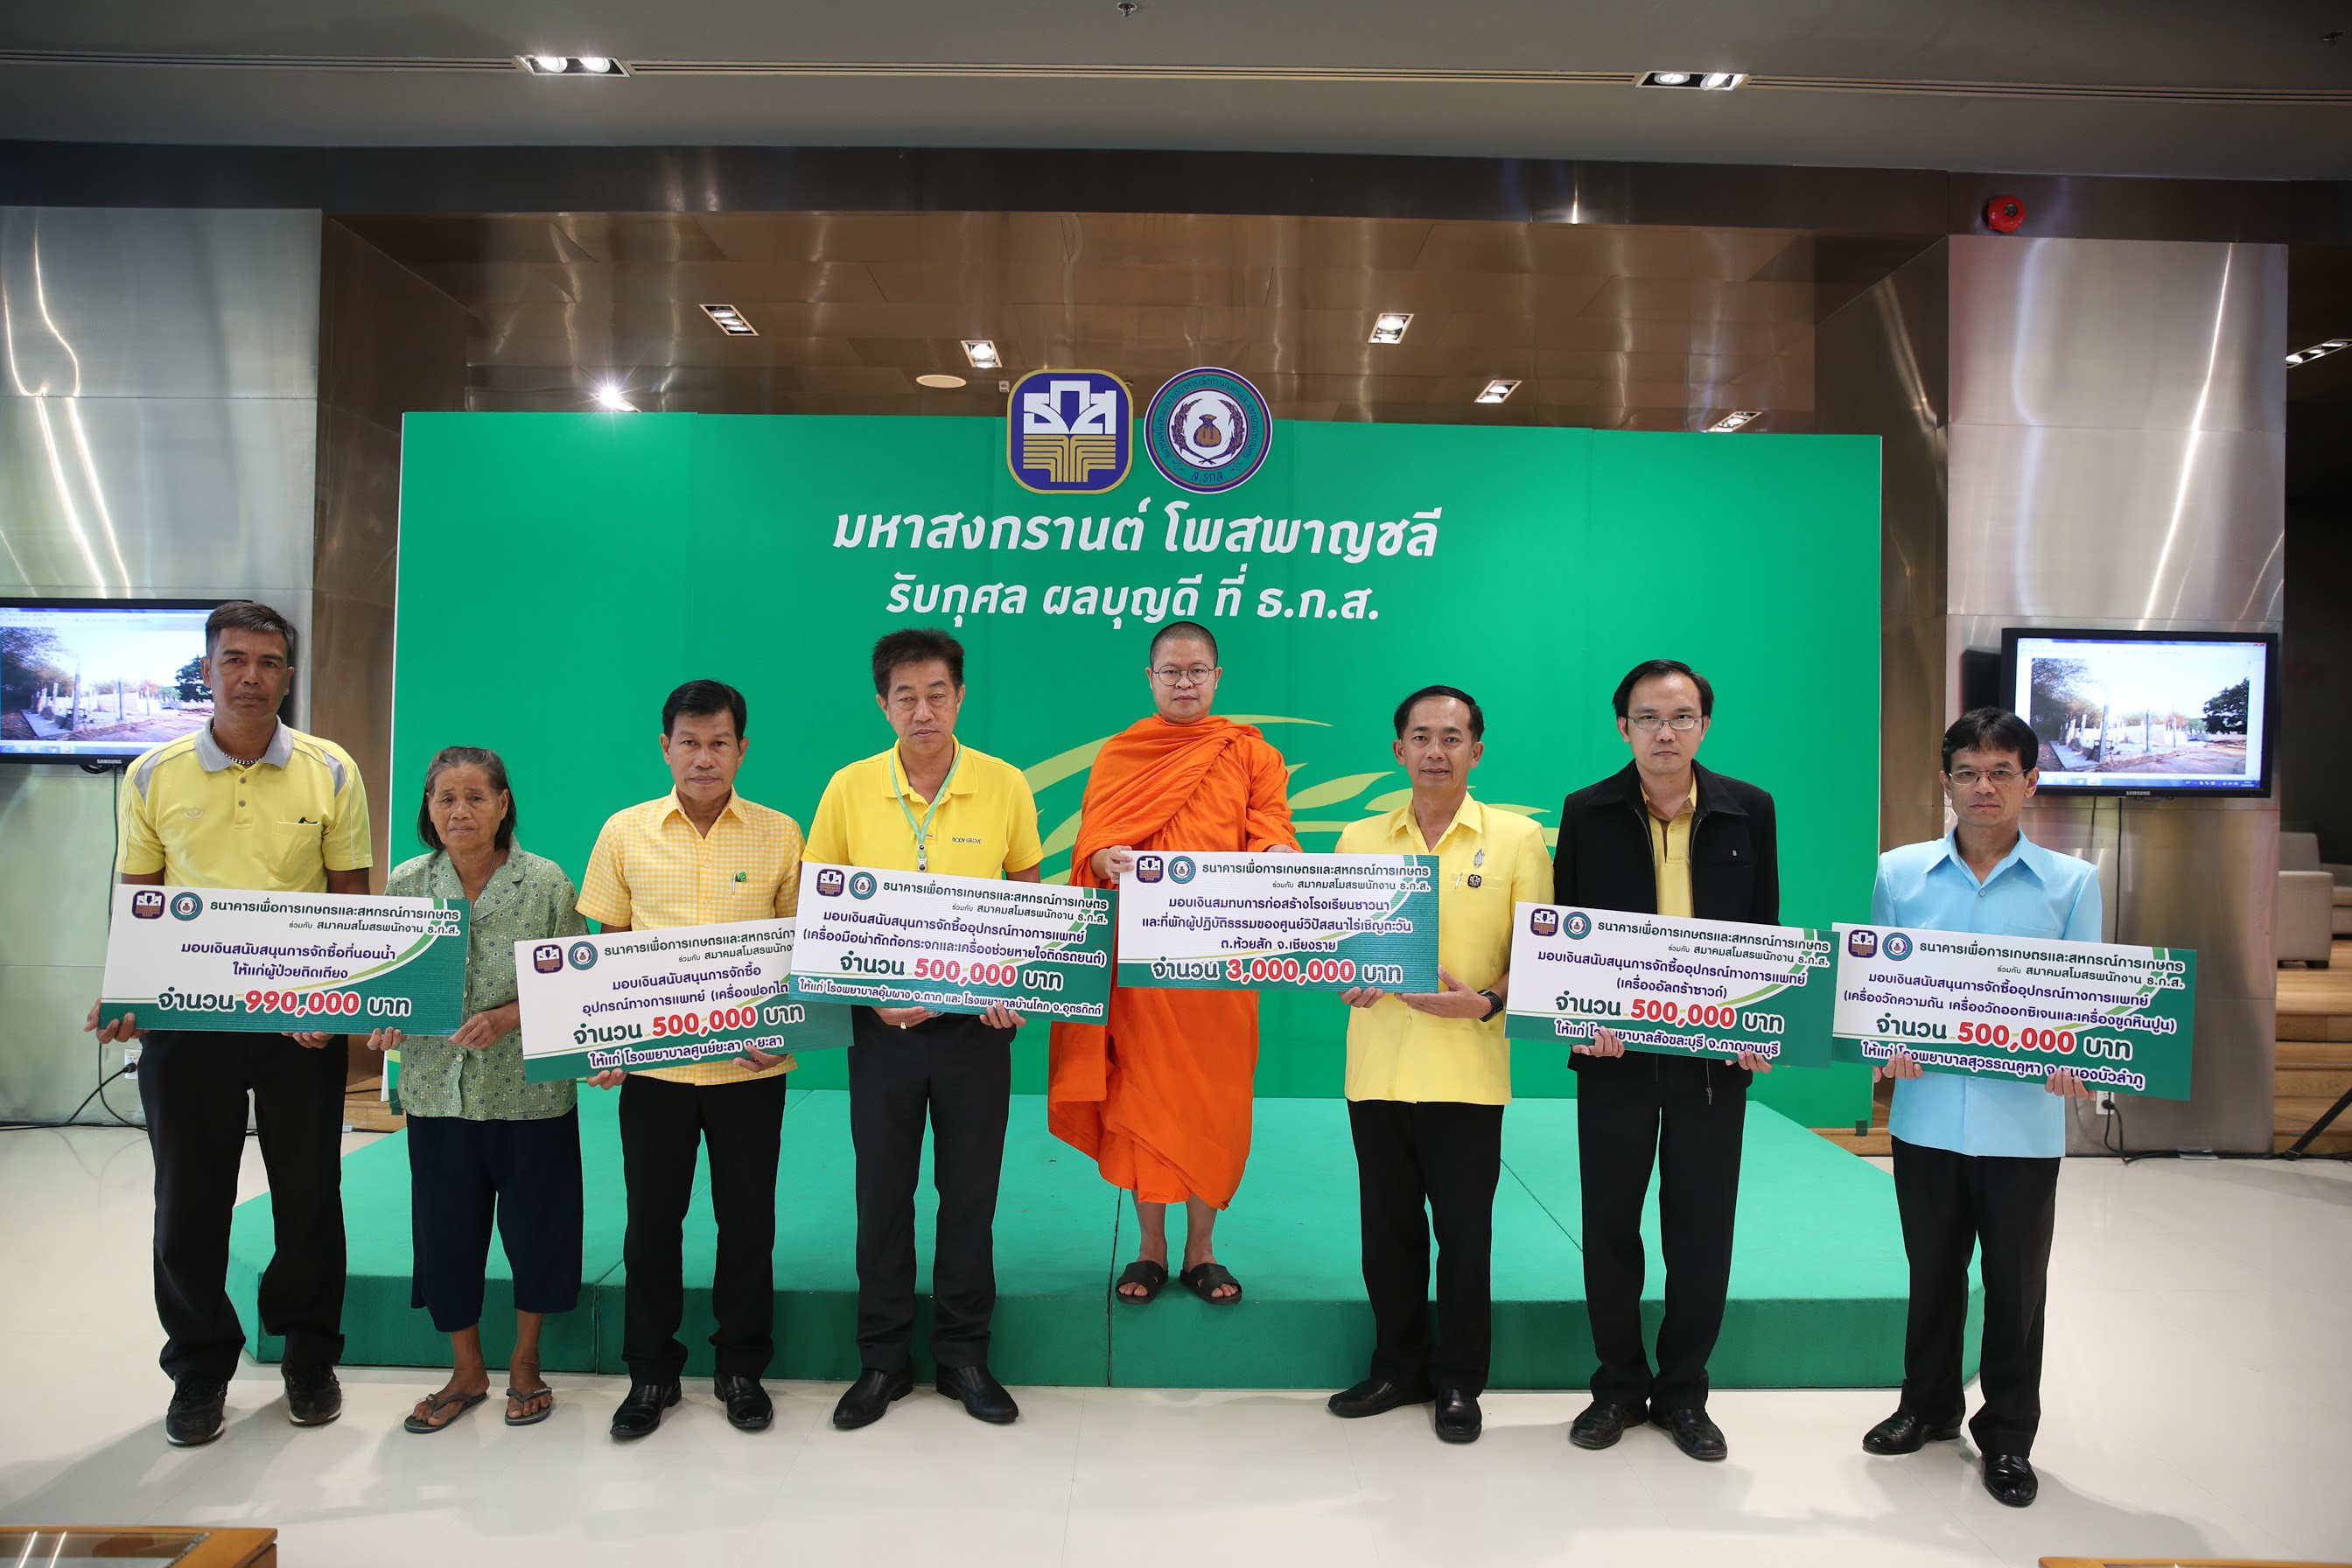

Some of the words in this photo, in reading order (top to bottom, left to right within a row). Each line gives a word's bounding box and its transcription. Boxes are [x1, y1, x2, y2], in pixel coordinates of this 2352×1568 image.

[833, 497, 1150, 550] มหาสงกรานต์
[1164, 501, 1443, 564] โพสพาญชลี
[886, 573, 1027, 627] รับกุศล
[1043, 574, 1202, 629] ผลบุญดี
[1214, 564, 1247, 616] ที่
[1257, 584, 1380, 620] ธ.ก.ส.
[1202, 859, 1429, 877] ธนาคารเพื่อการเกษตรและสหกรณ์การเกษตร
[883, 879, 1107, 910] ธนาคารเพื่อการเกษตรและสหกรณ์การเกษตร
[1272, 880, 1294, 889] ร่วมกับ
[1298, 879, 1396, 890] สมาคมสโมสรพนักงาน
[1400, 882, 1430, 892] ธ.ก.ส.
[210, 898, 460, 920] ธนาคารเพื่อการเกษตรและสหกรณ์การเกษตร
[952, 903, 974, 912] ร่วมกับ
[976, 904, 1074, 920] สมาคมสโมสรพนักงาน
[1077, 914, 1107, 924] ธ.ก.ส.
[1169, 895, 1390, 911] มอบเงินสมทบการก่อสร้างโรงเรียนชาวนา
[289, 920, 313, 929] ร่วมกับ
[317, 920, 424, 934] สมาคมสโมสรพนักงาน
[428, 926, 460, 935] ธ.ก.ส.
[823, 911, 1084, 942] มอบเงินสนับสนุนการจัดซื้ออุปกรณ์ทางการแพทย์
[1142, 912, 1411, 933] และที่พักผู้ปฏิบัติธรรมของศูนย์วิปัสสนาไร่เชิญตะวัน
[1598, 921, 1830, 951] ธนาคารเพื่อการเกษตรและสหกรณ์การเกษตร
[181, 941, 396, 960] มอบเงินสนับสนุนการจัดซื้อที่นอนน้ำ
[604, 928, 794, 956] ธนาคารเพื่อการเกษตรและสหกรณ์กา
[679, 953, 701, 962] ร่วมกับ
[704, 942, 794, 961] สมาคมสโมสรพนักง
[803, 925, 1106, 965] (เครื่องมือผ่าตัดต้อกระจกและเครื่องช่วยหายใจติดรถยนต์)
[1221, 937, 1272, 950] ต.ห้วยสัก
[1277, 939, 1336, 951] จ.เชียงราย
[1668, 944, 1690, 954] ร่วมกับ
[1693, 946, 1794, 963] สมาคมสโมสรพนักงาน
[1797, 956, 1829, 966] ธ.ก.ส.
[233, 962, 348, 980] ให้แก่ผู้ป่วยติดเตียง
[840, 951, 905, 976] จำนวน
[914, 958, 1017, 984] 500,000
[1023, 970, 1062, 990] บาท
[1153, 956, 1218, 978] จำนวน
[1227, 961, 1354, 984] 3,000,000
[1363, 964, 1402, 983] บาท
[1537, 950, 1806, 984] มอบเงินสนับสนุนการจัดซื้ออุปกรณ์ทางการแพทย์
[1920, 942, 2184, 972] ธนาคารเพื่อการเกษตรและสหกรณ์การเกษตร
[612, 962, 761, 990] มอบเงินสนับสนุนการจัดซื้อ
[1616, 977, 1727, 999] (เครื่องอัลตร้าซาวด์)
[1868, 971, 2148, 1006] มอบเงินสนับสนุนการจัดซื้ออุปกรณ์ทางการแพทย์
[1997, 964, 2021, 974] ร่วมกับ
[2026, 967, 2142, 984] สมาคมสโมสรพนักงาน
[2146, 976, 2184, 988] ธ.ก.ส.
[158, 988, 235, 1011] จำนวน
[245, 990, 360, 1016] 990,000
[368, 997, 410, 1016] บาท
[583, 989, 706, 1015] อุปกรณ์ทางการแพทย์
[710, 980, 790, 1003] (เครื่องฟอกไต
[800, 977, 823, 991] ให้แก่
[826, 980, 911, 1000] โรงพยาบาลอุ้มผาง
[914, 992, 942, 1004] จ.ตาก
[945, 994, 962, 1004] และ
[964, 993, 1049, 1010] โรงพยาลบ้านโคก
[1053, 1003, 1102, 1016] จ.อุตรดิตถ์
[1844, 989, 1944, 1010] (เครื่องวัดความดัน
[1949, 996, 2176, 1032] เครื่องวัดออกซิเจนและเครื่องขูดหินปูน)
[1555, 990, 1621, 1017] จำนวน
[1631, 999, 1735, 1026] 500,000
[1743, 1013, 1784, 1032] บาท
[573, 1022, 642, 1046] จำนวน
[652, 1006, 756, 1035] 500,000
[765, 1005, 803, 1024] บาท
[1556, 1020, 1585, 1036] ให้แก่
[1876, 1013, 1947, 1040] จำนวน
[1957, 1022, 2075, 1051] 500,000
[2084, 1037, 2132, 1059] บาท
[590, 1052, 620, 1068] ให้แก่
[625, 1039, 741, 1062] โรงพยาบาลศูนย์ยะลา
[1863, 1041, 1894, 1057] ให้แก่
[1898, 1046, 2040, 1075] โงพยาบาลสุวรรณคูหา
[2046, 1066, 2143, 1088] จนองบัวลำภู
